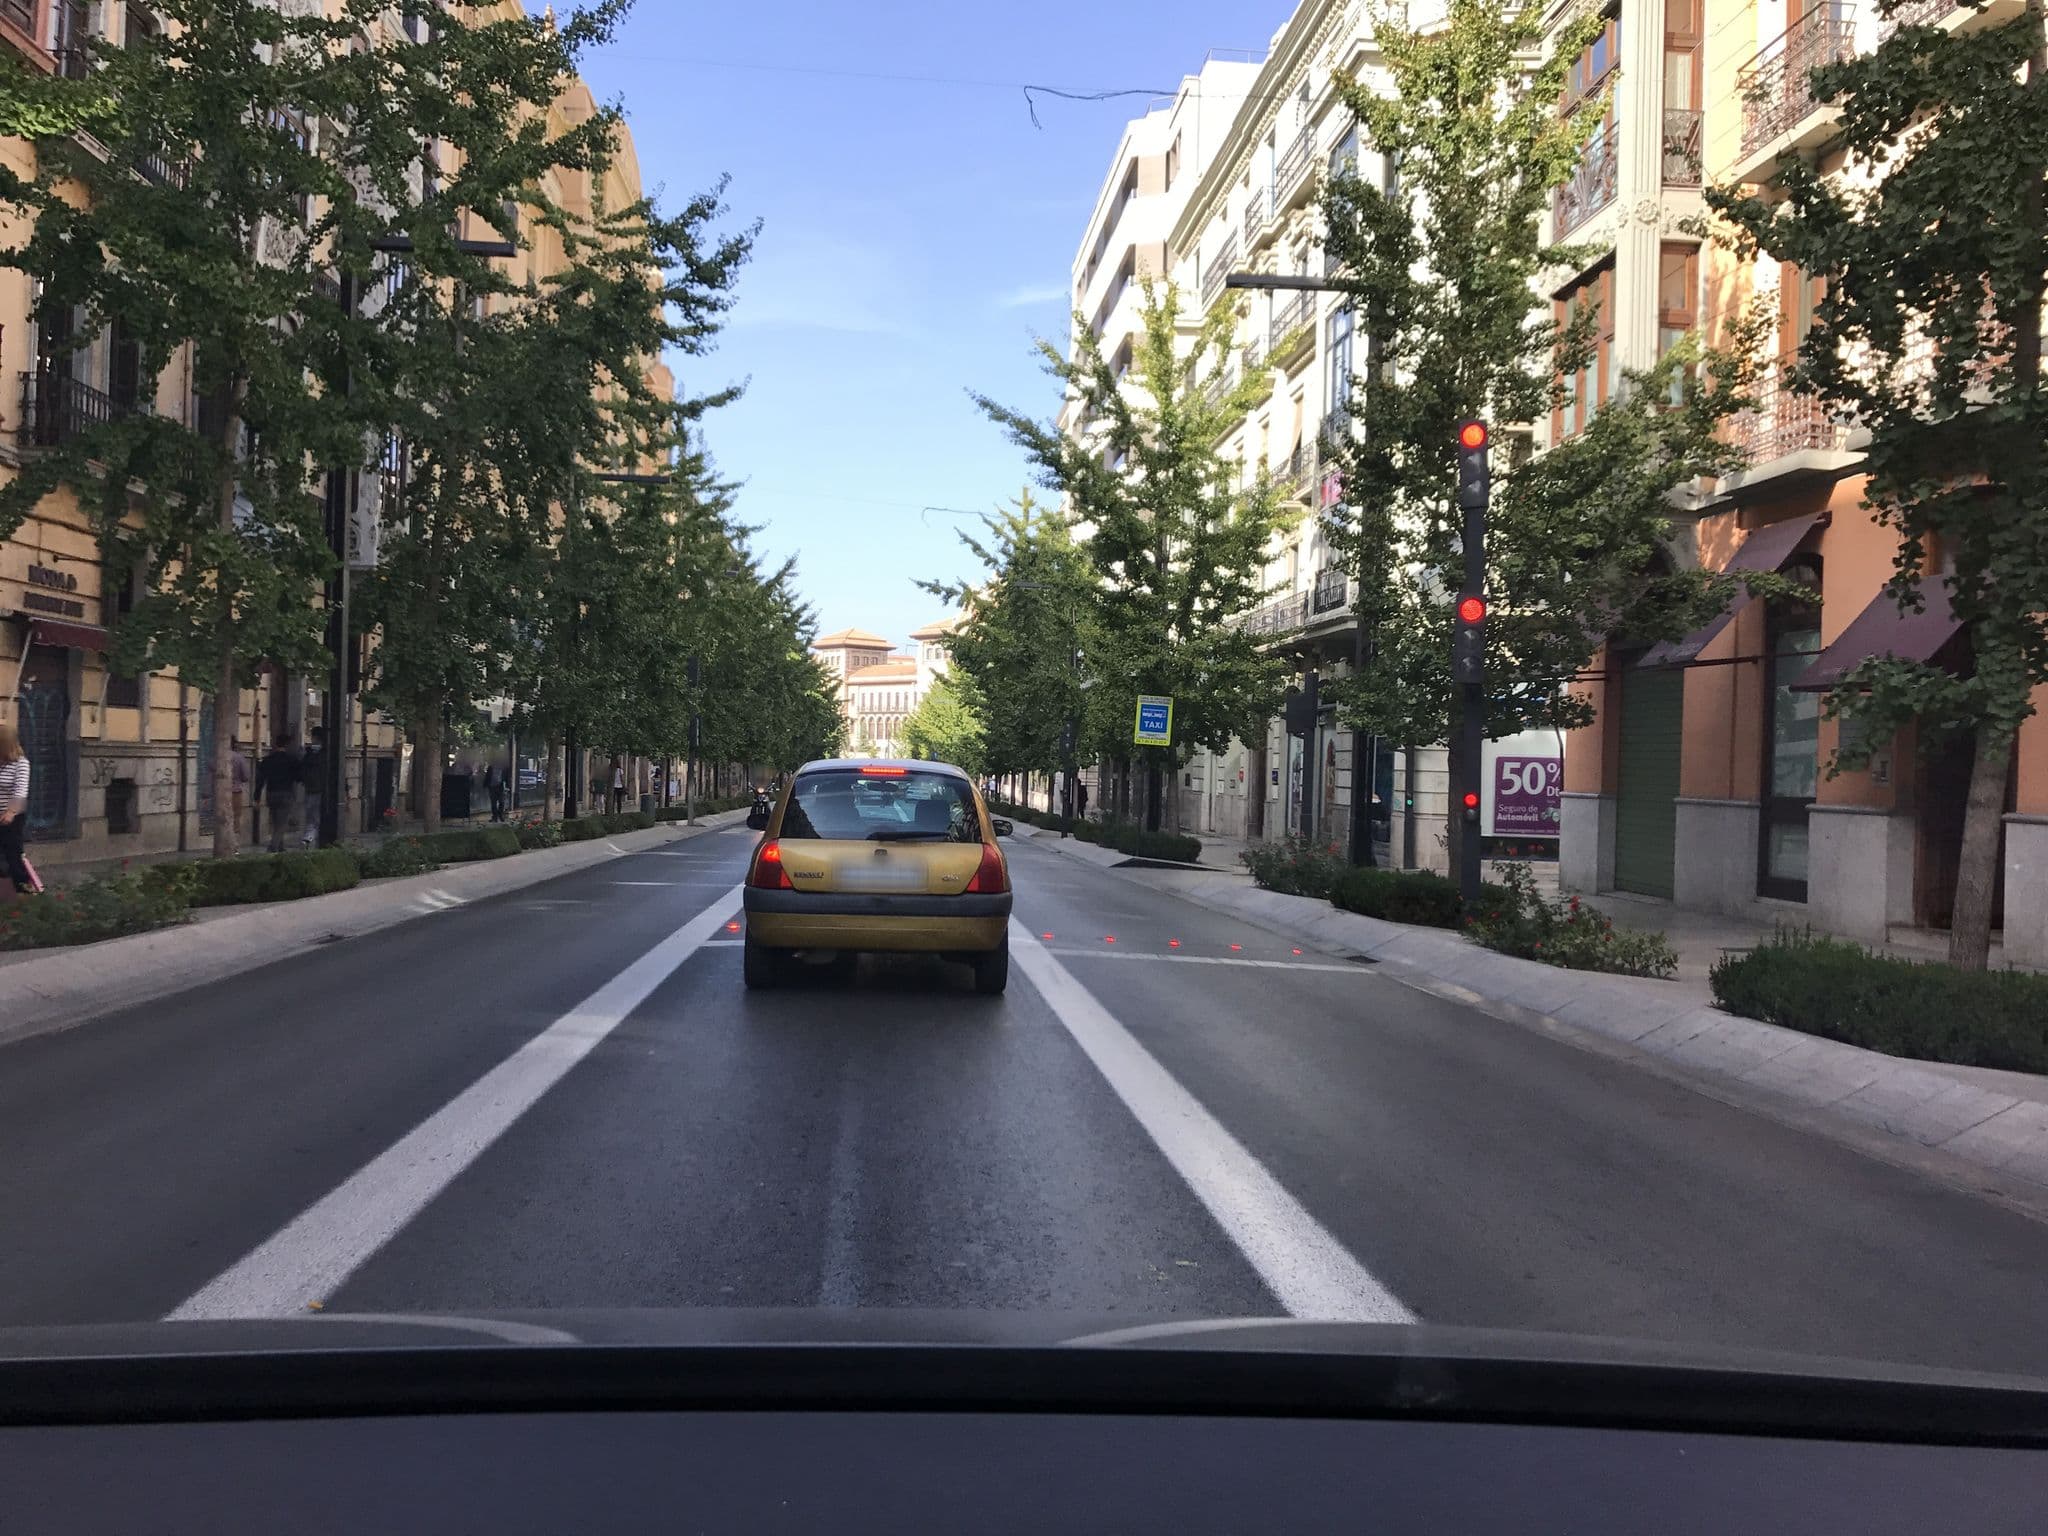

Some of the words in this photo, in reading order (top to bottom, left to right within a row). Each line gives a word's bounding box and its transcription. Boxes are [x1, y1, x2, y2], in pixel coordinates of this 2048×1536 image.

[1143, 720, 1164, 729] TAXI
[1546, 785, 1560, 797] Dt
[1498, 803, 1527, 814] Seguro
[1528, 804, 1539, 813] de
[1496, 813, 1539, 822] Automóvil
